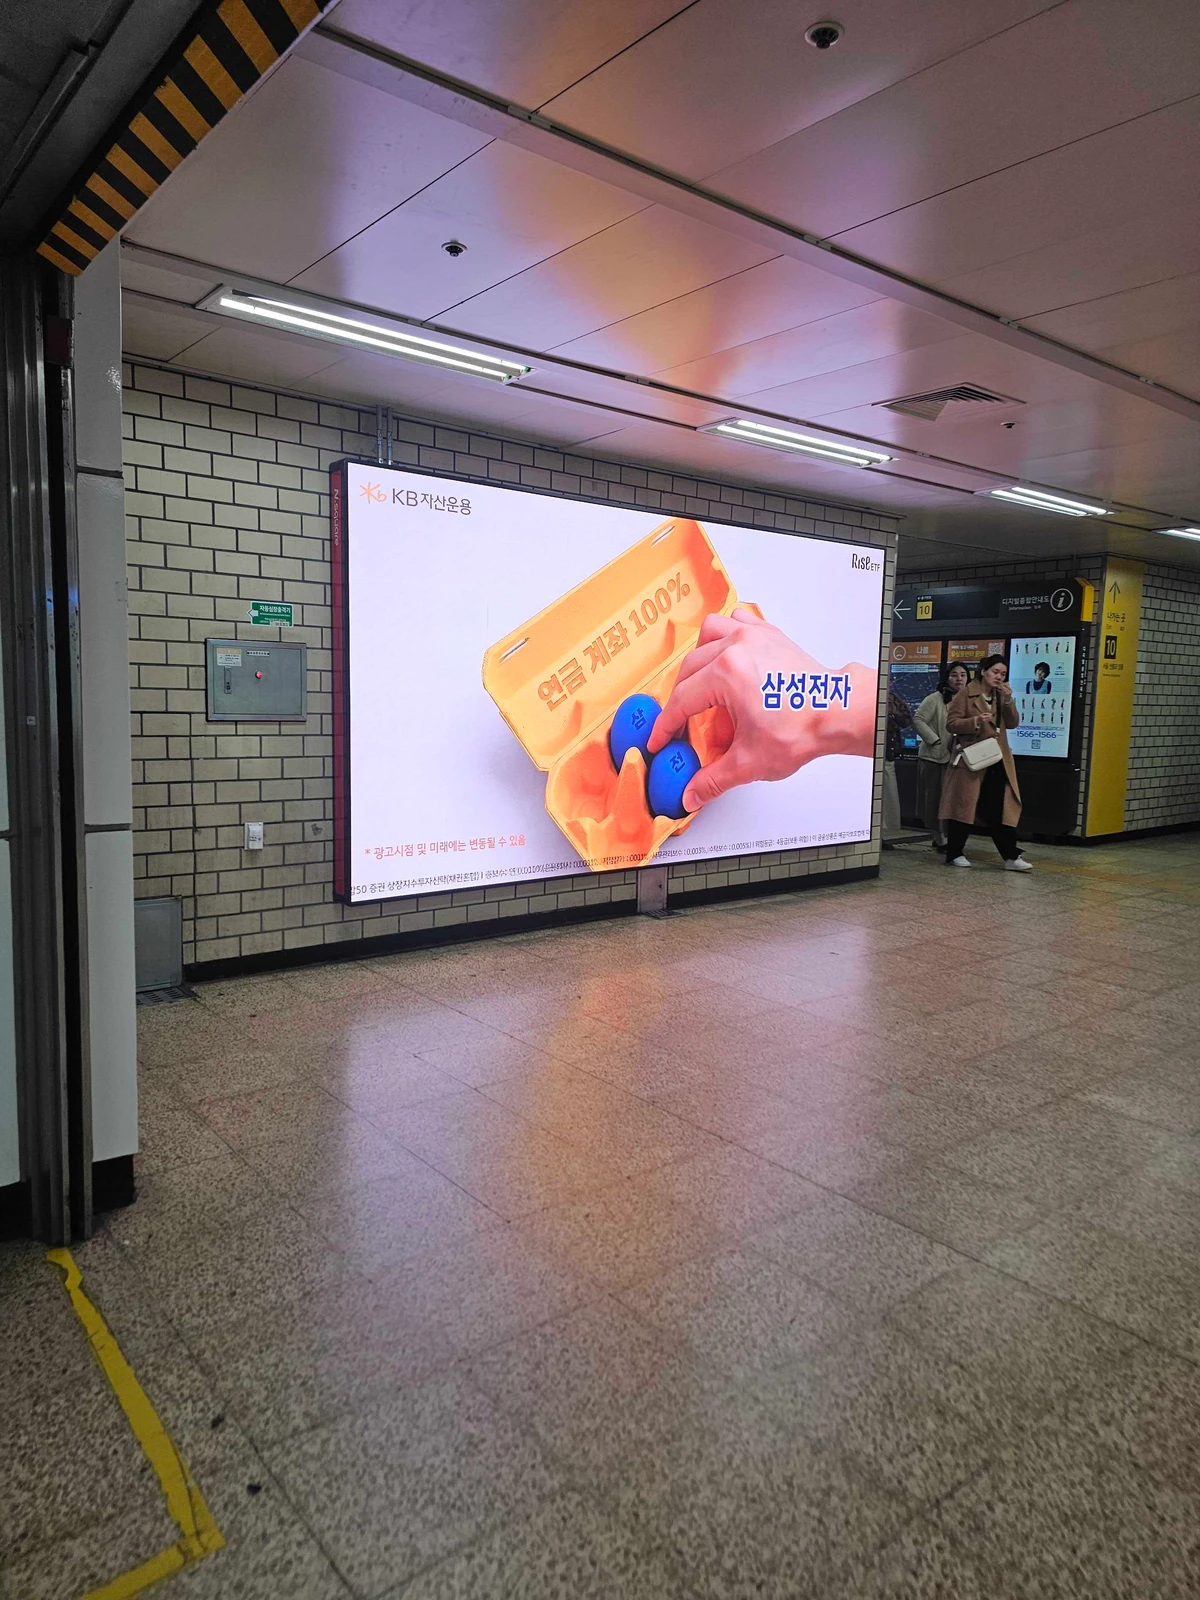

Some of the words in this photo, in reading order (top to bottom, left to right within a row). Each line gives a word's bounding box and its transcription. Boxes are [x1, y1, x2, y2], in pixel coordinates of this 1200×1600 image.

[871, 562, 881, 572] ETF
[919, 605, 930, 615] 10
[537, 657, 588, 712] 연금
[583, 620, 631, 673] 계좌
[628, 571, 691, 638] 100%
[1106, 639, 1116, 656] 10
[761, 672, 852, 710] 삼성전자
[631, 707, 647, 731] 삼
[1016, 730, 1057, 739] 1566-1566
[669, 750, 686, 774] 전
[373, 844, 414, 860] 광고시점
[416, 843, 427, 856] 및
[429, 839, 467, 854] 미래에는
[469, 836, 496, 851] 변동될
[498, 836, 507, 847] 수
[509, 833, 526, 847] 있음
[369, 882, 386, 894] 증권
